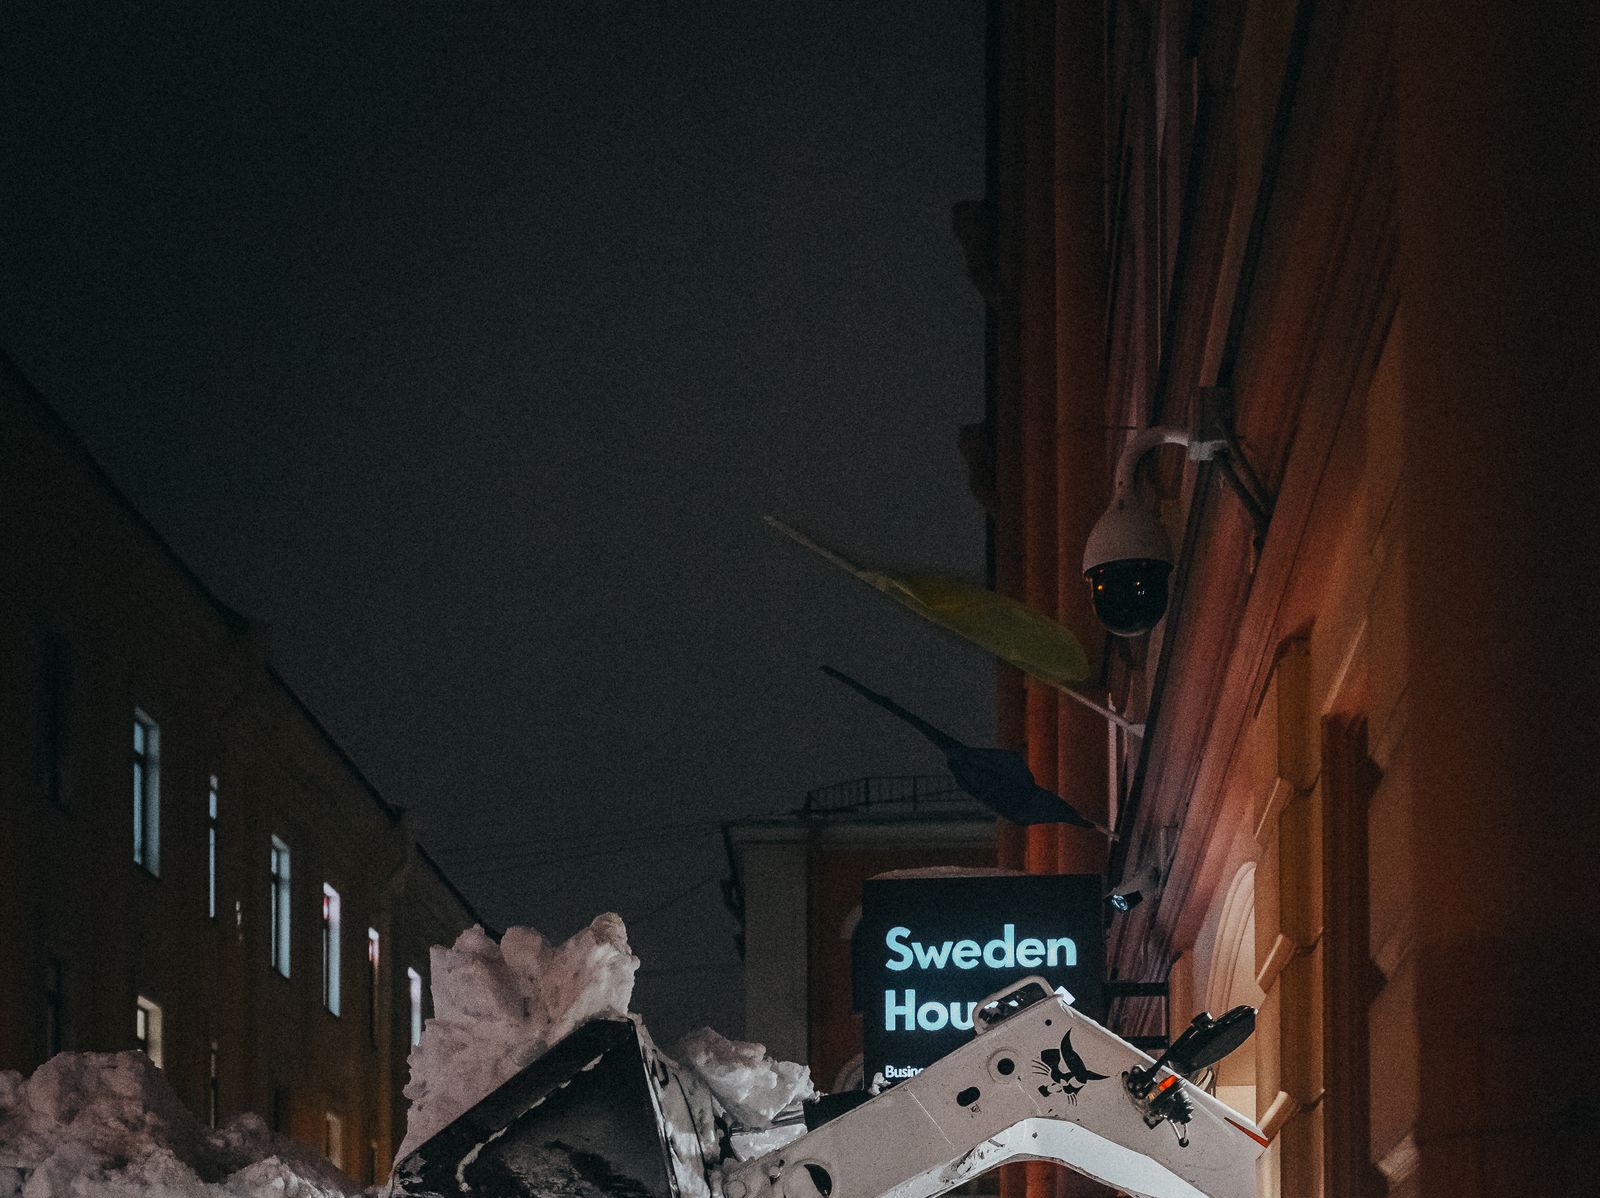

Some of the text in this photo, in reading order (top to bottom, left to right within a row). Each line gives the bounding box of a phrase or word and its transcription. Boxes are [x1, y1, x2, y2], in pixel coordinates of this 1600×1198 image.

[885, 924, 1077, 971] Sweden
[885, 989, 1019, 1031] Hou
[885, 1065, 924, 1078] Busin
